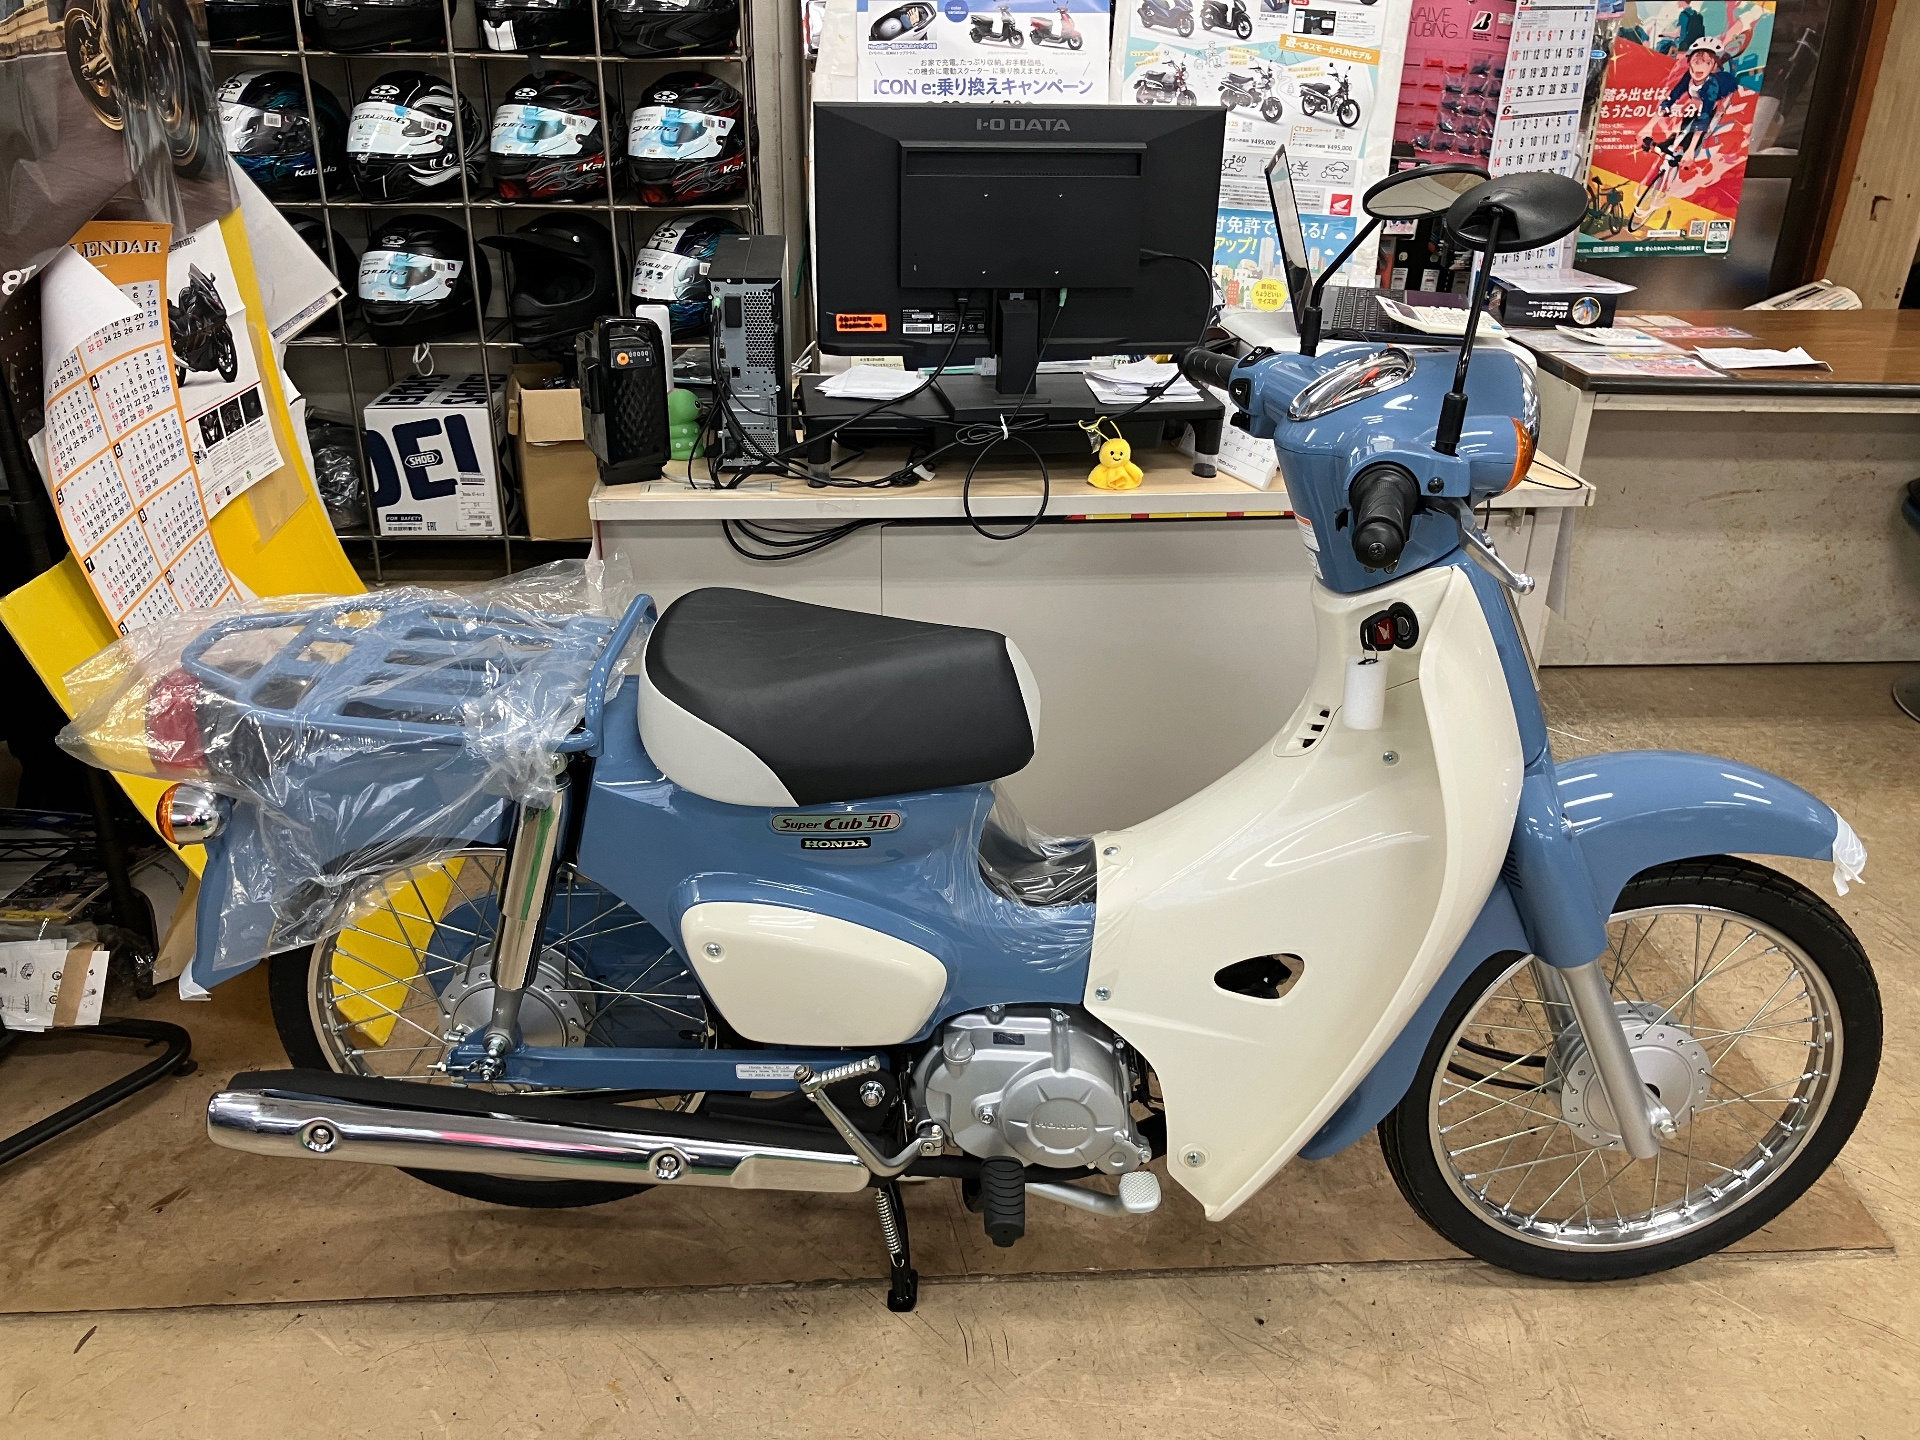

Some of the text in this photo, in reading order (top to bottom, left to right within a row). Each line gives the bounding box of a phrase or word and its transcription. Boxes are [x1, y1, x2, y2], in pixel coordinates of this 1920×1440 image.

[1573, 11, 1588, 22] 1 2
[1516, 31, 1520, 42] 3
[1527, 31, 1531, 42] 4
[1537, 30, 1541, 41] 5
[1548, 30, 1552, 41] 6
[1559, 30, 1563, 40] 7
[1570, 30, 1574, 40] 8
[1581, 30, 1585, 40] 9
[1523, 48, 1584, 60] 11 12 13 14 15 16
[1509, 65, 1581, 79] 17 18 19 20 21 22 23
[873, 78, 1094, 96] ICON e:乗り換えキャンペーン
[1516, 83, 1578, 97] 25 26 27 28 29 30
[1603, 87, 1672, 102] 踏み出せば、
[1502, 106, 1511, 115] 6
[1600, 103, 1703, 118] もうたのしい気分!
[1009, 118, 1070, 132] DATA
[1512, 116, 1572, 131] 1 2 3 4 5 6
[1509, 133, 1570, 148] 8 9 10 11 12 13
[1236, 156, 1247, 164] 60
[1494, 150, 1568, 167] 14 15 16 17 18 19 20
[1502, 247, 1555, 264] 14 15 16 17 18
[104, 335, 111, 343] 24
[113, 331, 121, 339] 25
[124, 327, 133, 335] 26
[92, 376, 97, 388] 4
[115, 446, 121, 456] 6
[410, 455, 436, 466] SHOEI
[57, 491, 64, 502] 5
[140, 510, 146, 520] 8
[85, 558, 92, 571] 7
[780, 815, 892, 830] Super Cub 50
[804, 840, 868, 848] HONDA
